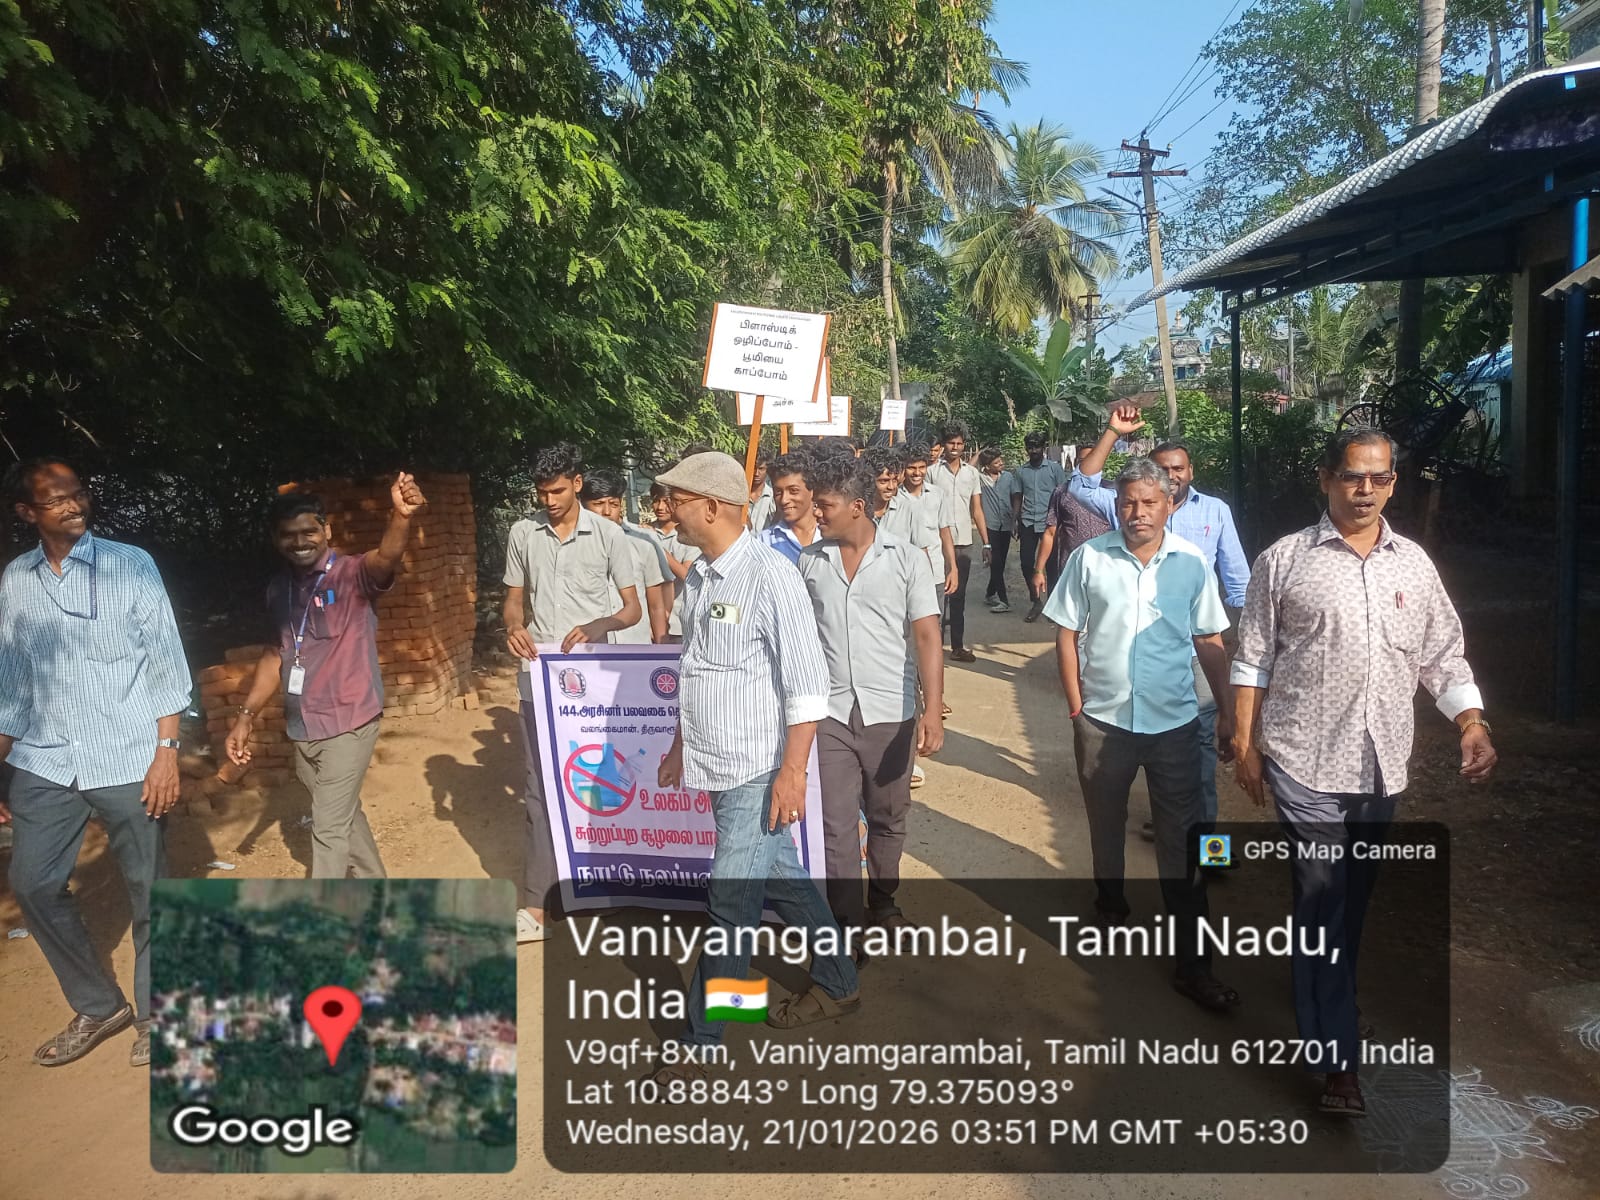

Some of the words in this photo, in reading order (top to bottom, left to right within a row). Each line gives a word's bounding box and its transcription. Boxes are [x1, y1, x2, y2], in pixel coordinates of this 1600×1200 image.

[739, 319, 797, 336] பிளாஸ்டிக்
[733, 334, 793, 350] ஒழிப்போம்
[742, 351, 784, 365] பூமியை
[734, 365, 788, 381] காப்போம்
[623, 705, 666, 717] பலவகை
[641, 724, 676, 735] திருவாரூ
[639, 788, 691, 811] உலகம்
[694, 790, 712, 814] அ
[575, 823, 638, 847] சுற்றுப்புற
[641, 828, 693, 849] சூழலை
[696, 831, 718, 846] பா
[576, 863, 635, 889] நாட்டு
